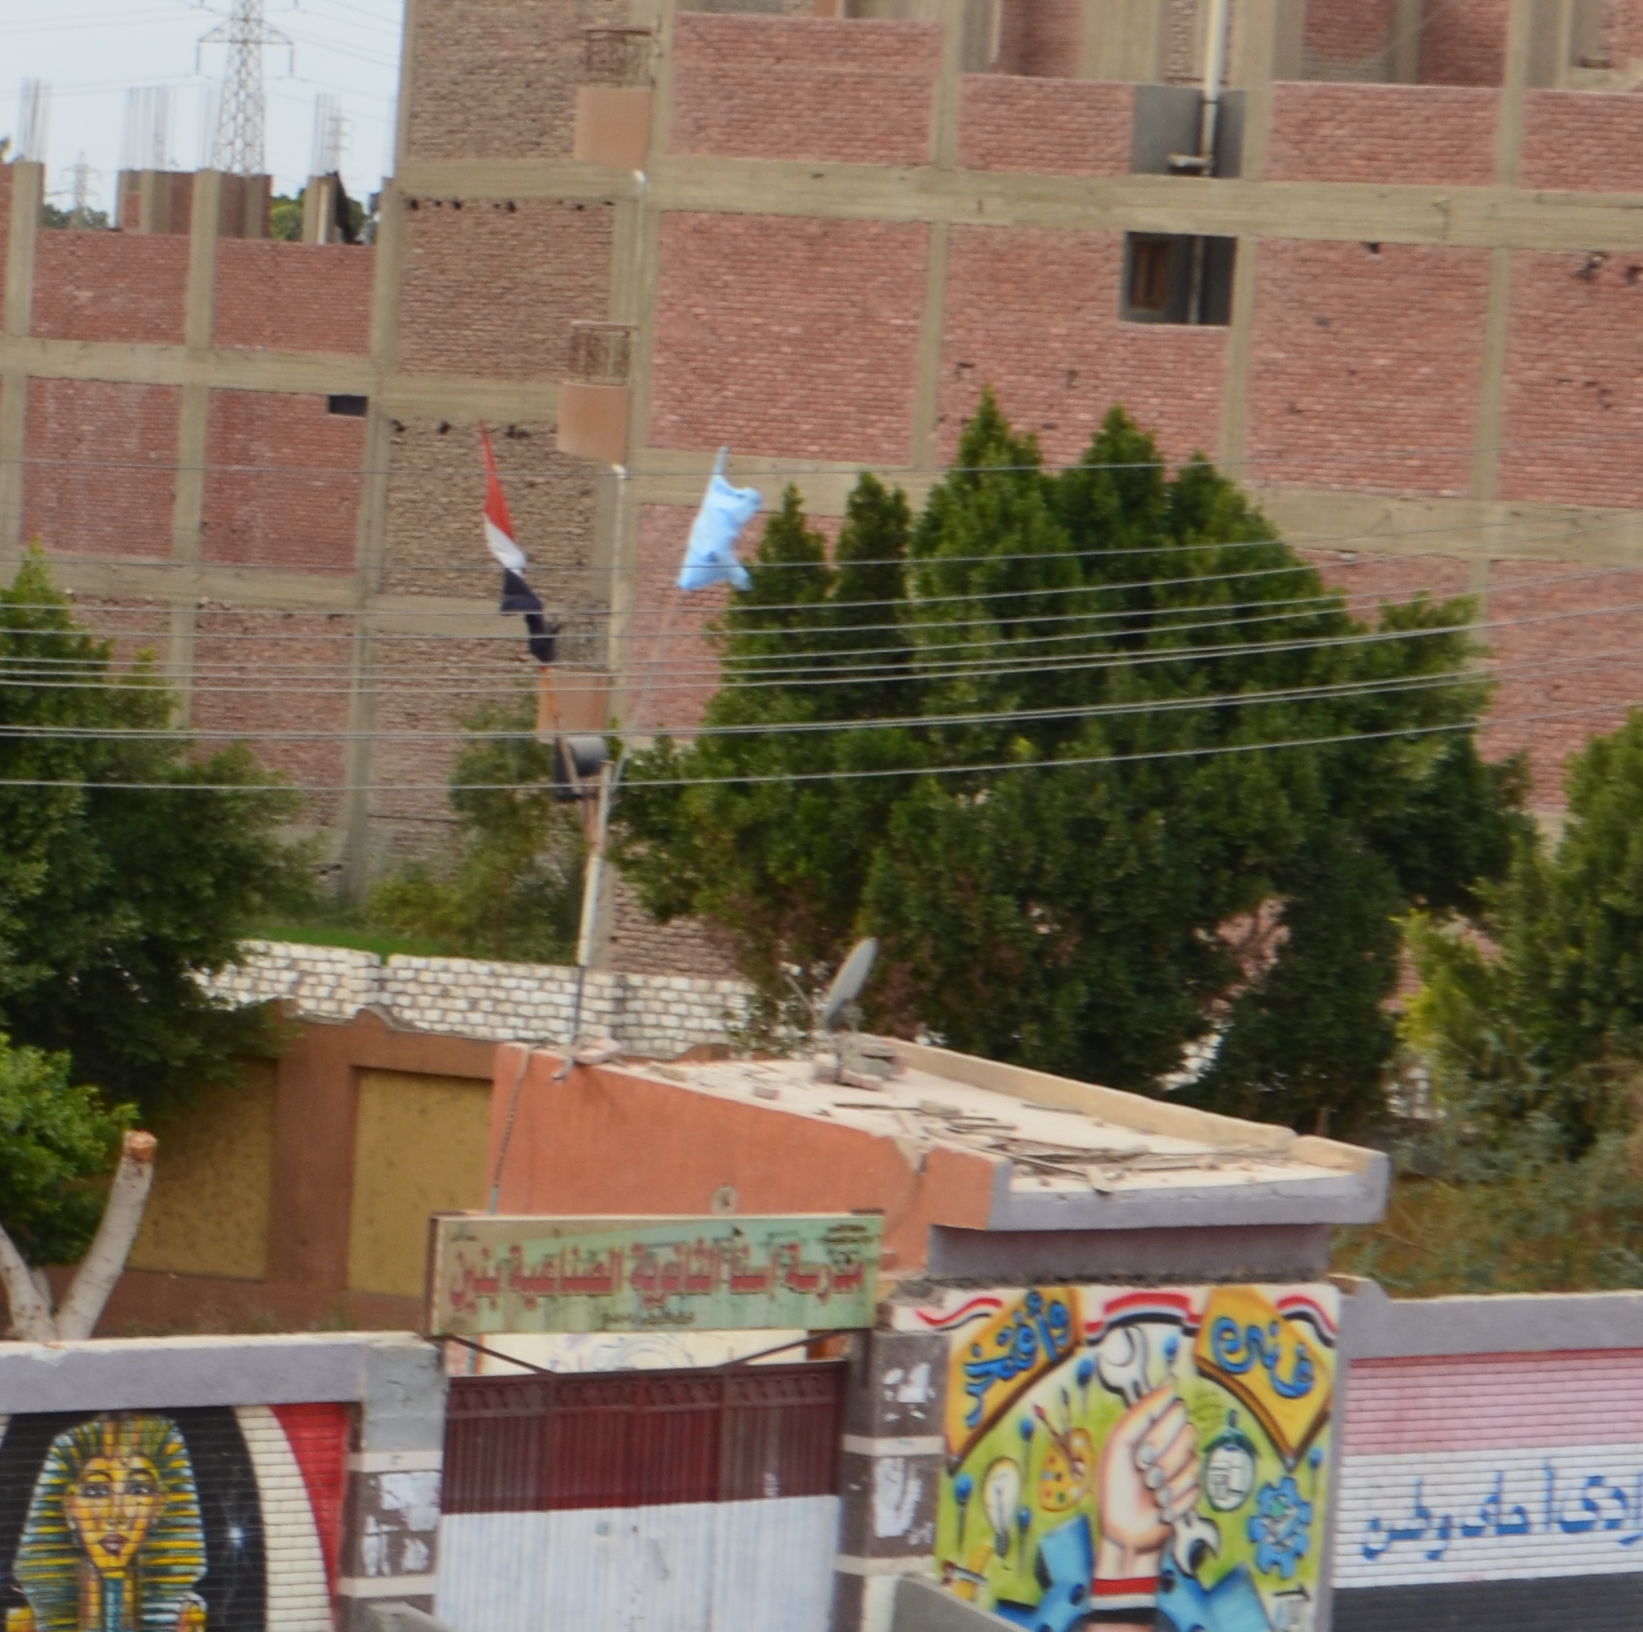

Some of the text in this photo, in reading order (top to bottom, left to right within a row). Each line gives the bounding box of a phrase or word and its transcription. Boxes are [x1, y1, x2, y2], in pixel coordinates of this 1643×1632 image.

[449, 1246, 503, 1313] بنين
[508, 1244, 625, 1310] الصناعية
[630, 1237, 721, 1309] الثانوية
[785, 1242, 864, 1304] مدرسة
[1362, 1476, 1451, 1562] وطن
